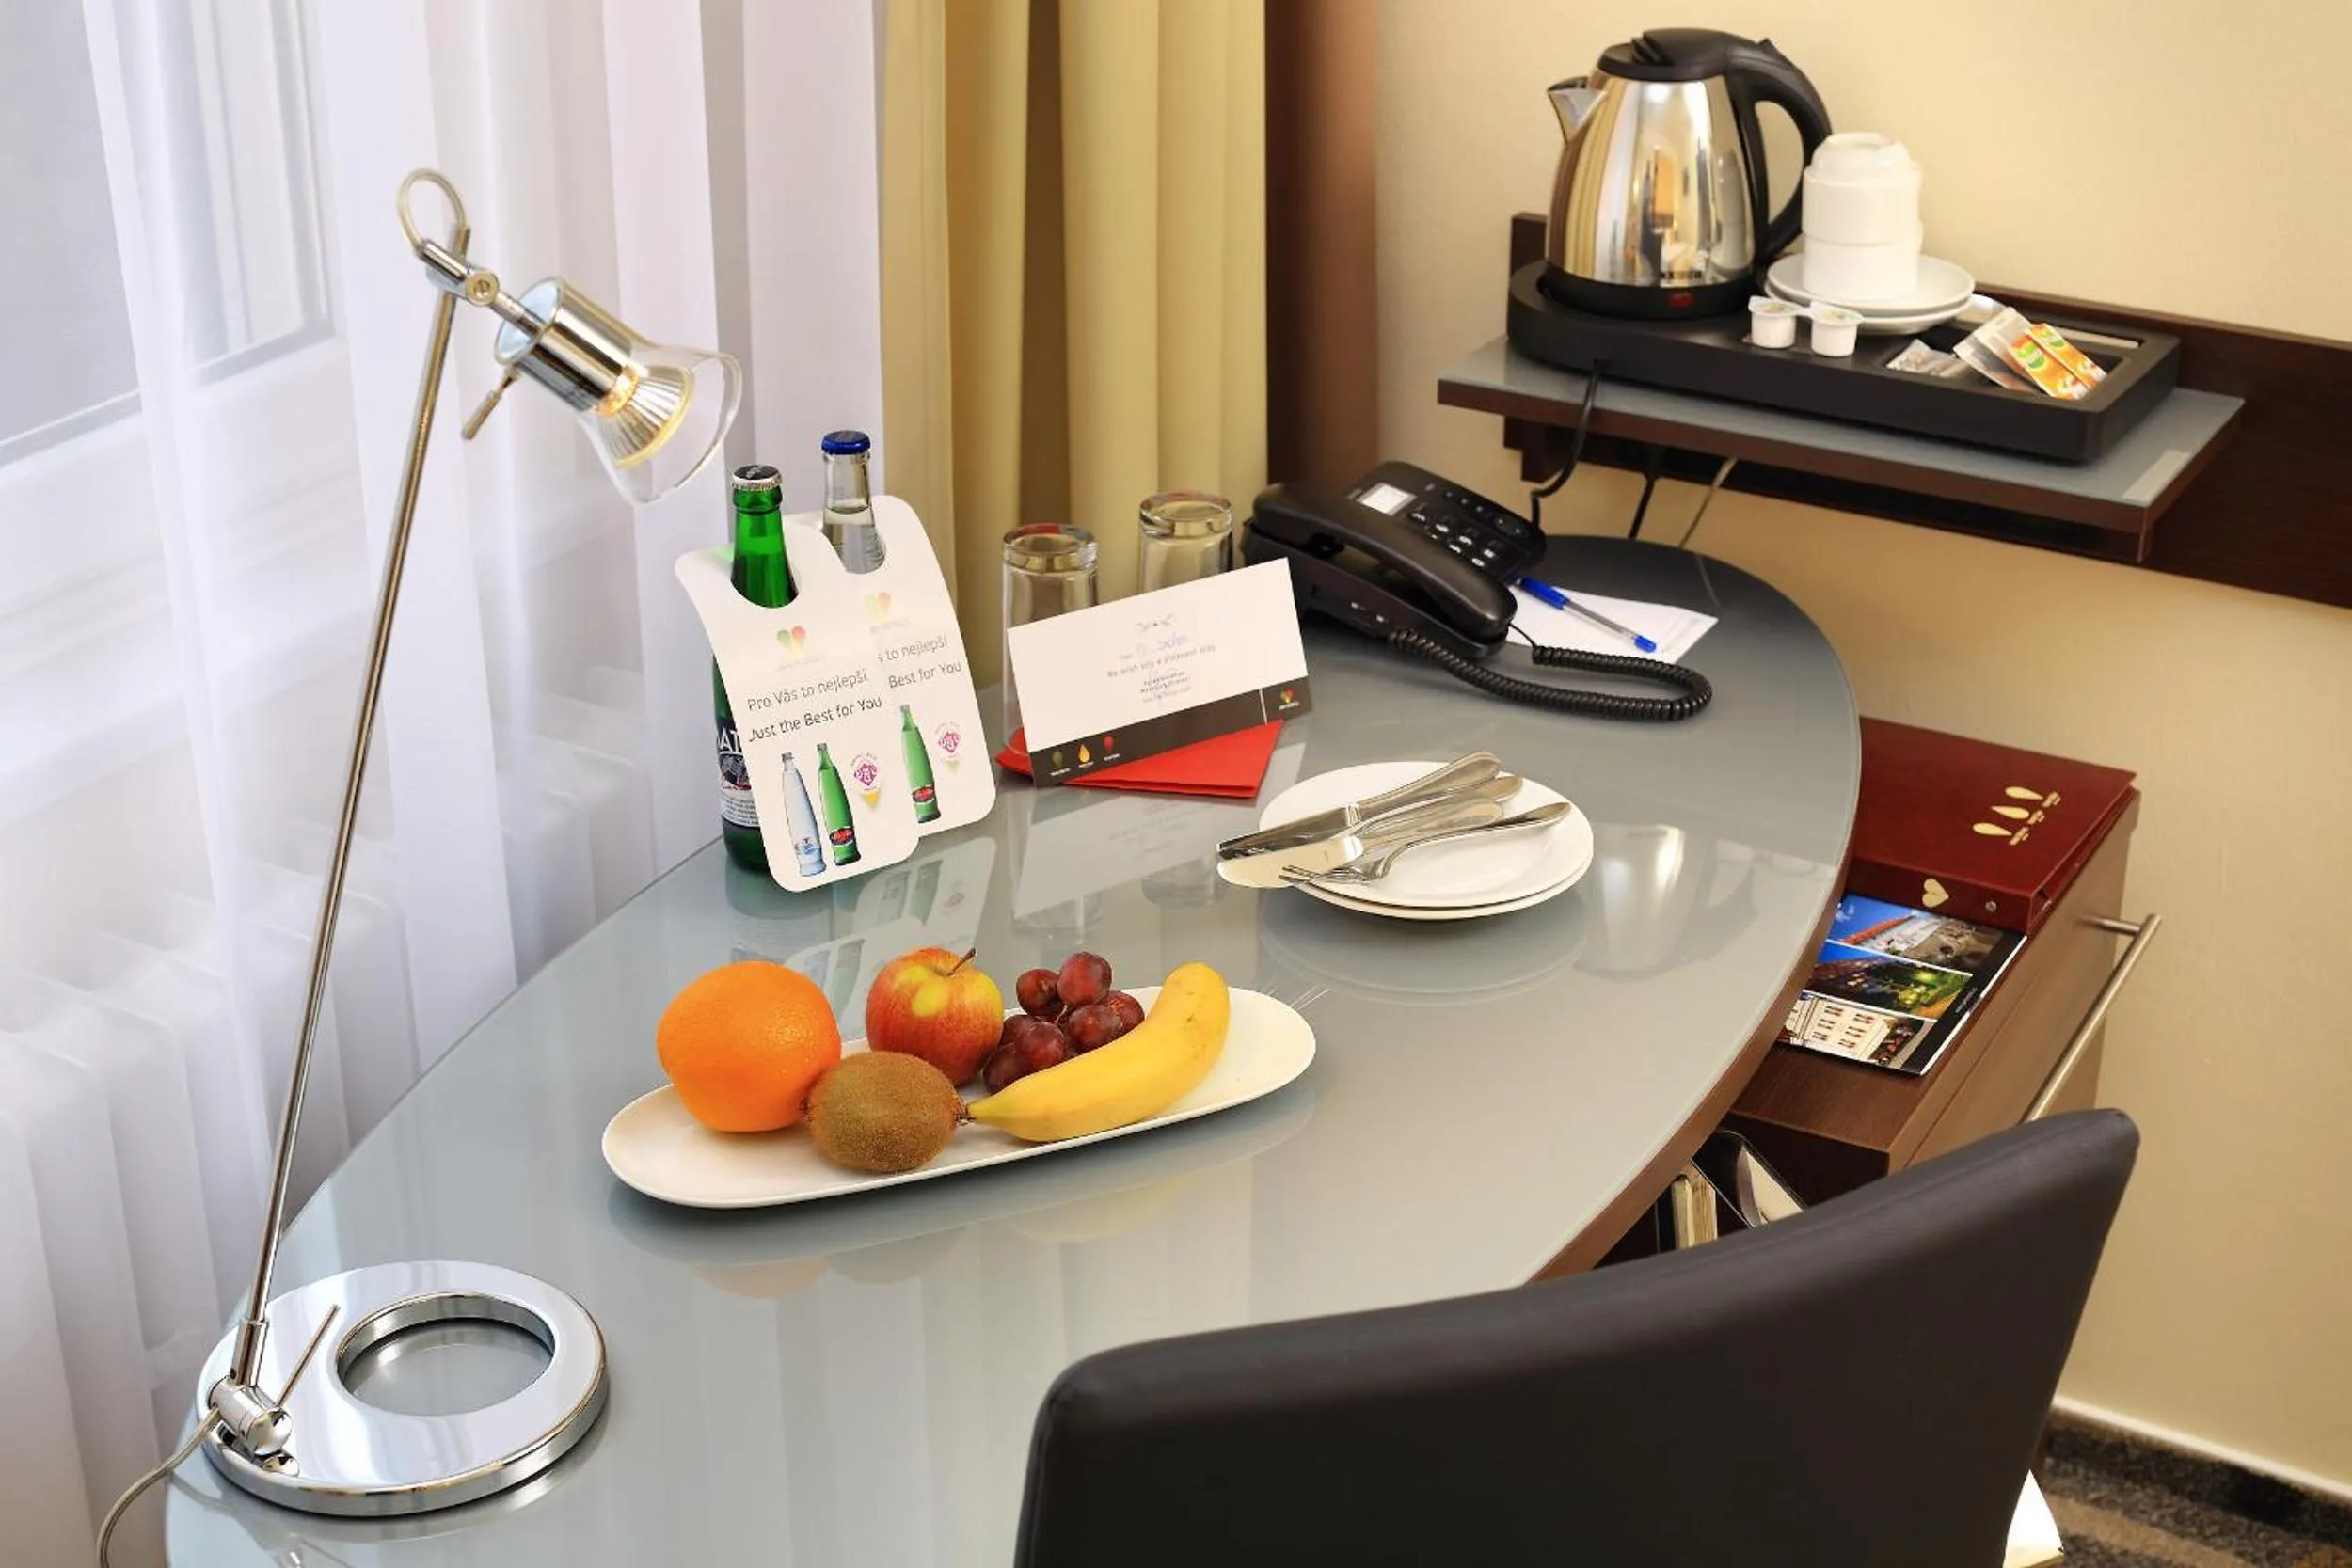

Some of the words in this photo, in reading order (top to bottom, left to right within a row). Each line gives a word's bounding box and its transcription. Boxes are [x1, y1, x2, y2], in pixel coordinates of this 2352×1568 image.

[888, 672, 917, 689] Best
[918, 667, 935, 682] for
[937, 661, 962, 676] You
[748, 697, 771, 711] Pro
[772, 689, 798, 705] Vás
[800, 686, 815, 699] to
[749, 724, 776, 743] Just
[779, 718, 801, 734] the
[803, 708, 834, 727] Best
[836, 703, 854, 718] for
[857, 696, 882, 712] You
